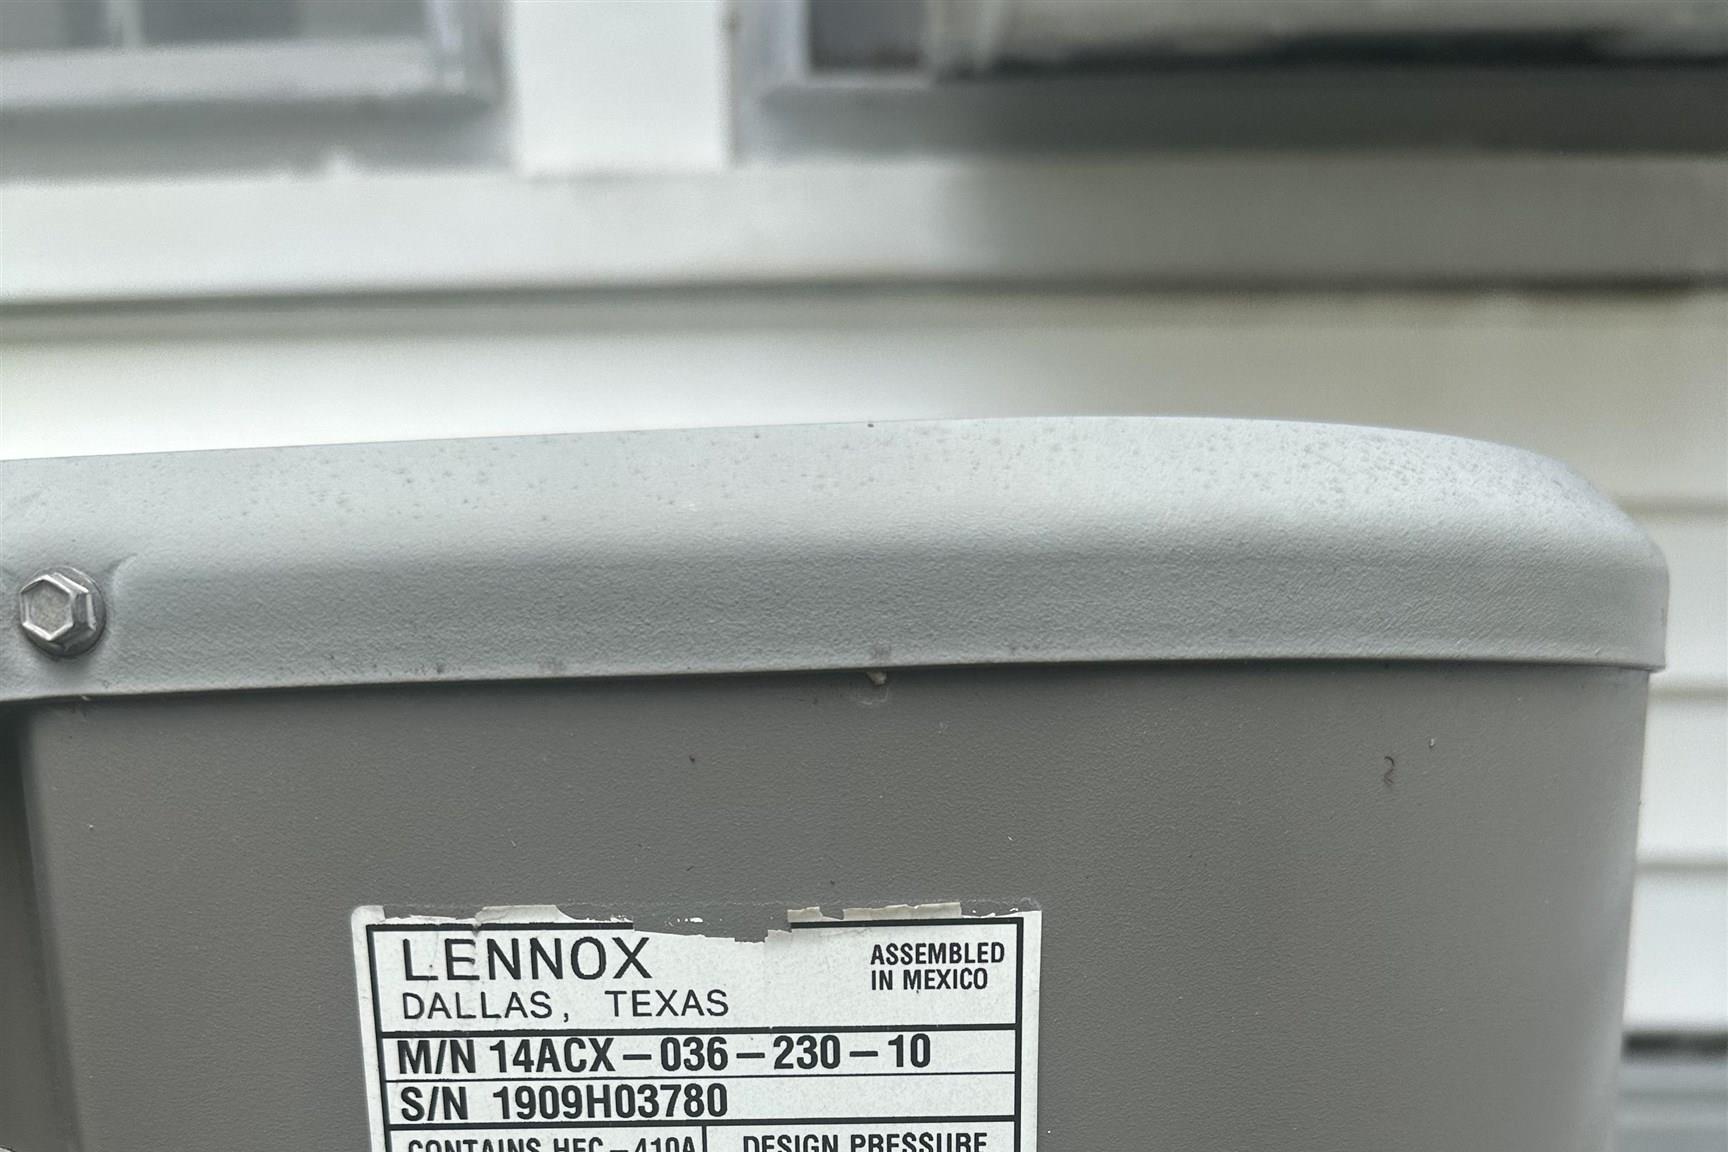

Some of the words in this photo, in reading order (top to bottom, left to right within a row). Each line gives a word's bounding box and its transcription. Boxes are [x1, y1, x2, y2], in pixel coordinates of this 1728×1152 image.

[402, 936, 652, 981] LENNOX
[870, 942, 1004, 965] ASSEMBLED
[870, 969, 895, 991] IN
[901, 968, 989, 990] MEXICO
[402, 991, 570, 1023] DALLAS,
[606, 989, 728, 1017] TEXAS
[399, 1038, 477, 1075] M/N
[400, 1086, 468, 1121] S/N
[493, 1082, 728, 1120] 1909H03780
